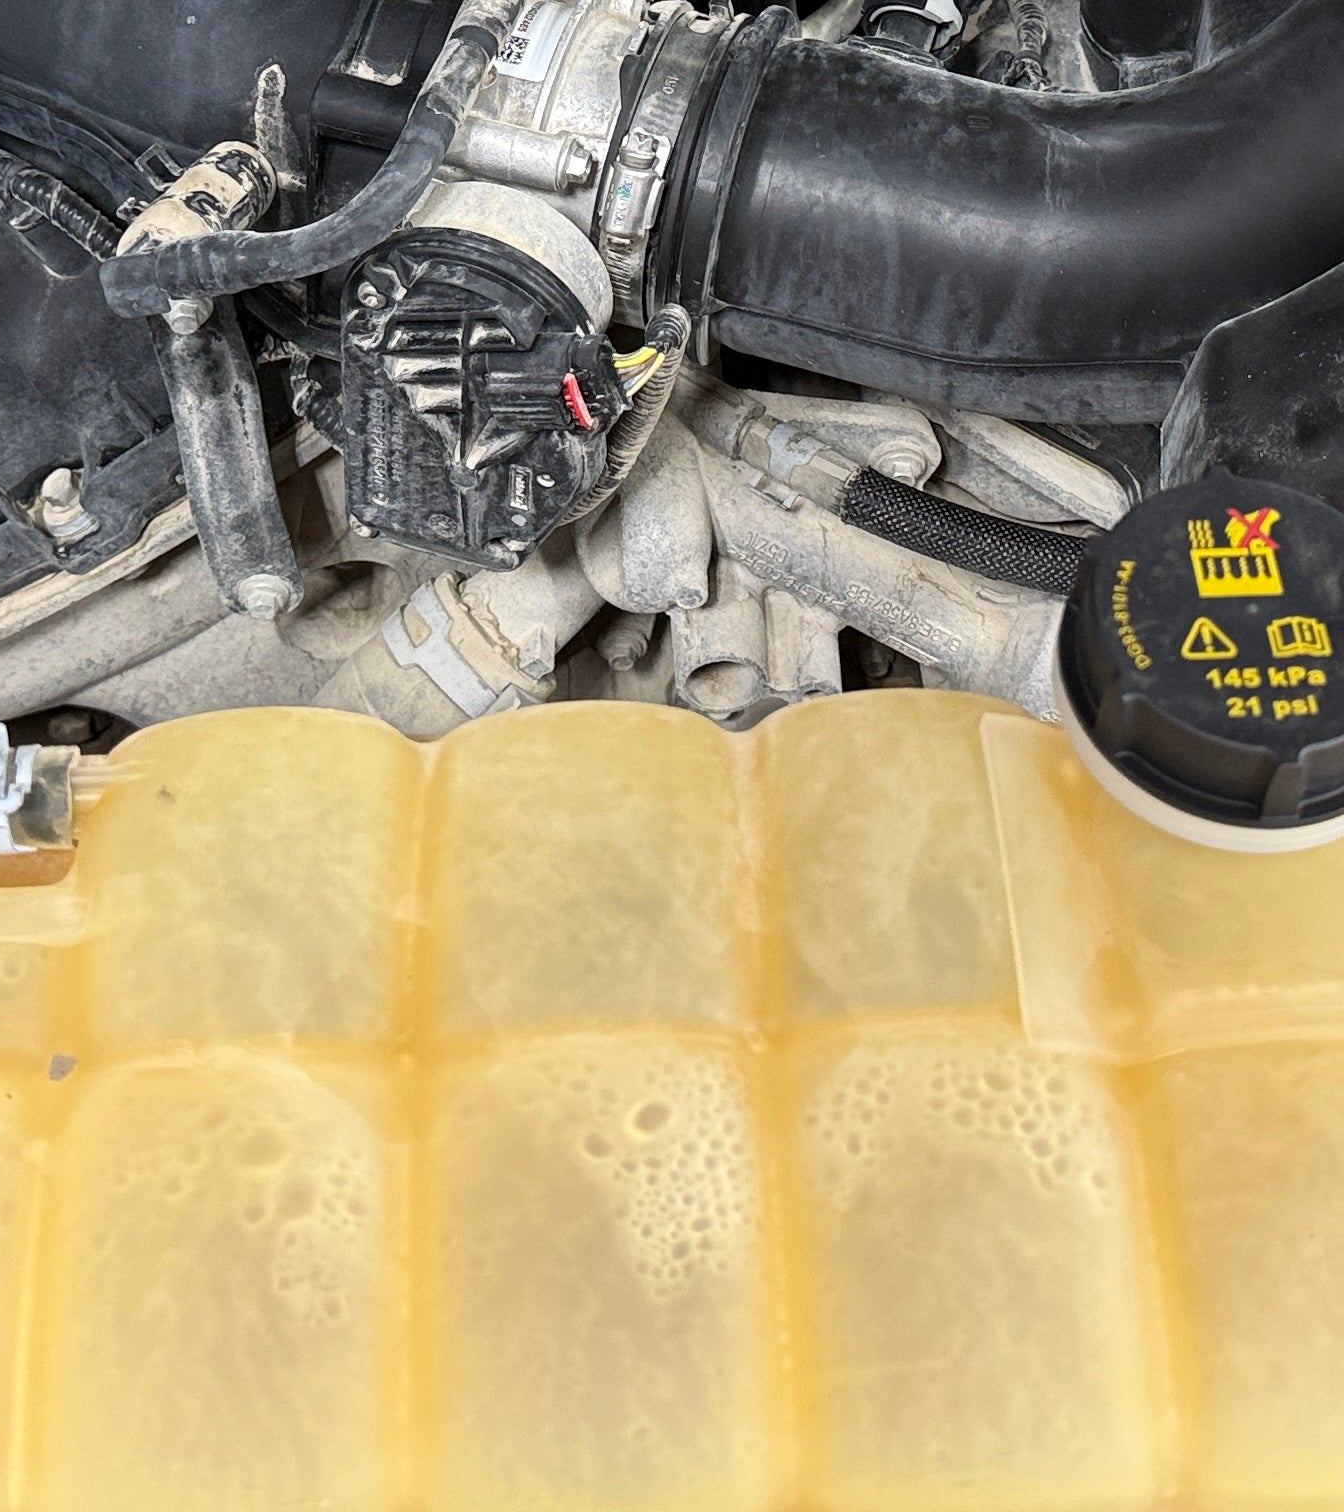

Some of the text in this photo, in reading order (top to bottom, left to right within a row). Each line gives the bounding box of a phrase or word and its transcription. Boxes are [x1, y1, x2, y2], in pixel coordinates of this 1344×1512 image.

[1206, 666, 1327, 689] 145 kPa
[1226, 694, 1319, 721] 21 psi
